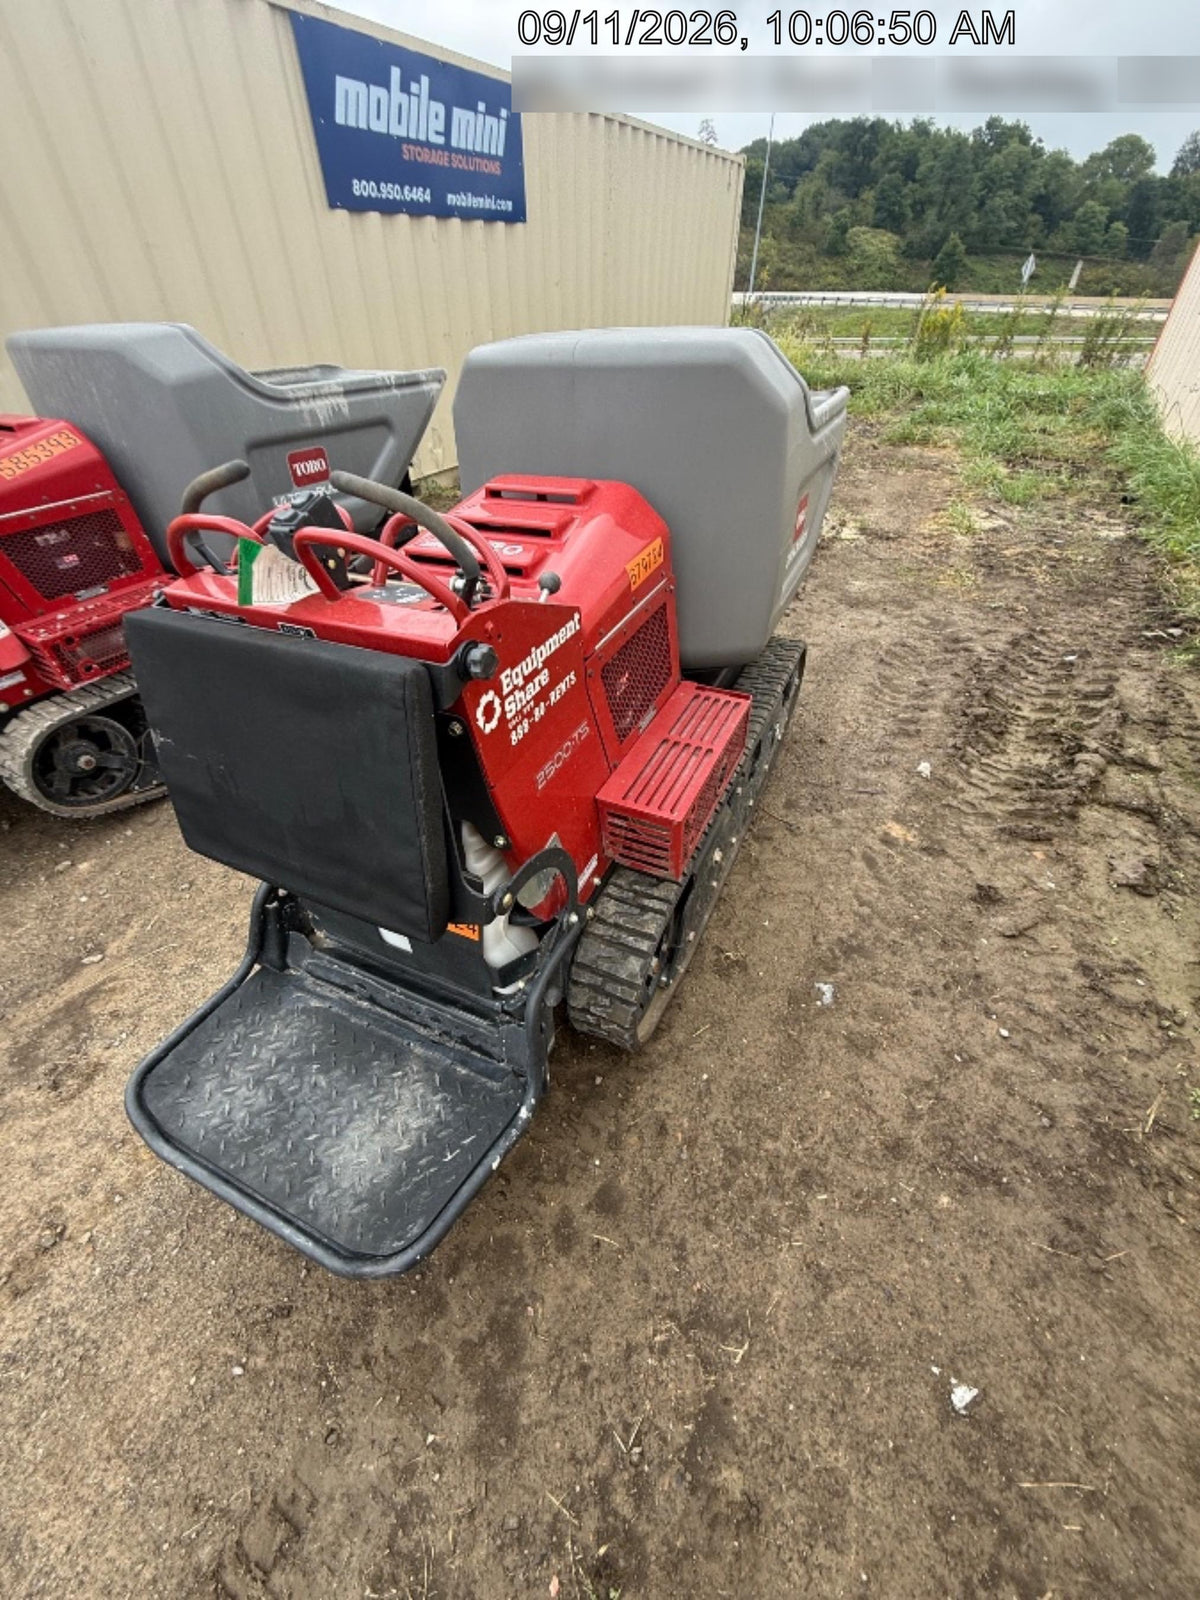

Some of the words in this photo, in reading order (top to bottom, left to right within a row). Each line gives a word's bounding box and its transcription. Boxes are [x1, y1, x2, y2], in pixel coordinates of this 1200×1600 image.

[335, 65, 446, 145] mobile
[451, 101, 508, 157] mini
[402, 143, 450, 167] STORAGE
[451, 154, 502, 176] SOLUTIONS
[352, 178, 431, 203] 800.950.6464
[447, 191, 513, 211] mobilemini.com
[292, 458, 327, 477] TORO
[499, 611, 581, 696] Equipment
[503, 668, 550, 720] Share
